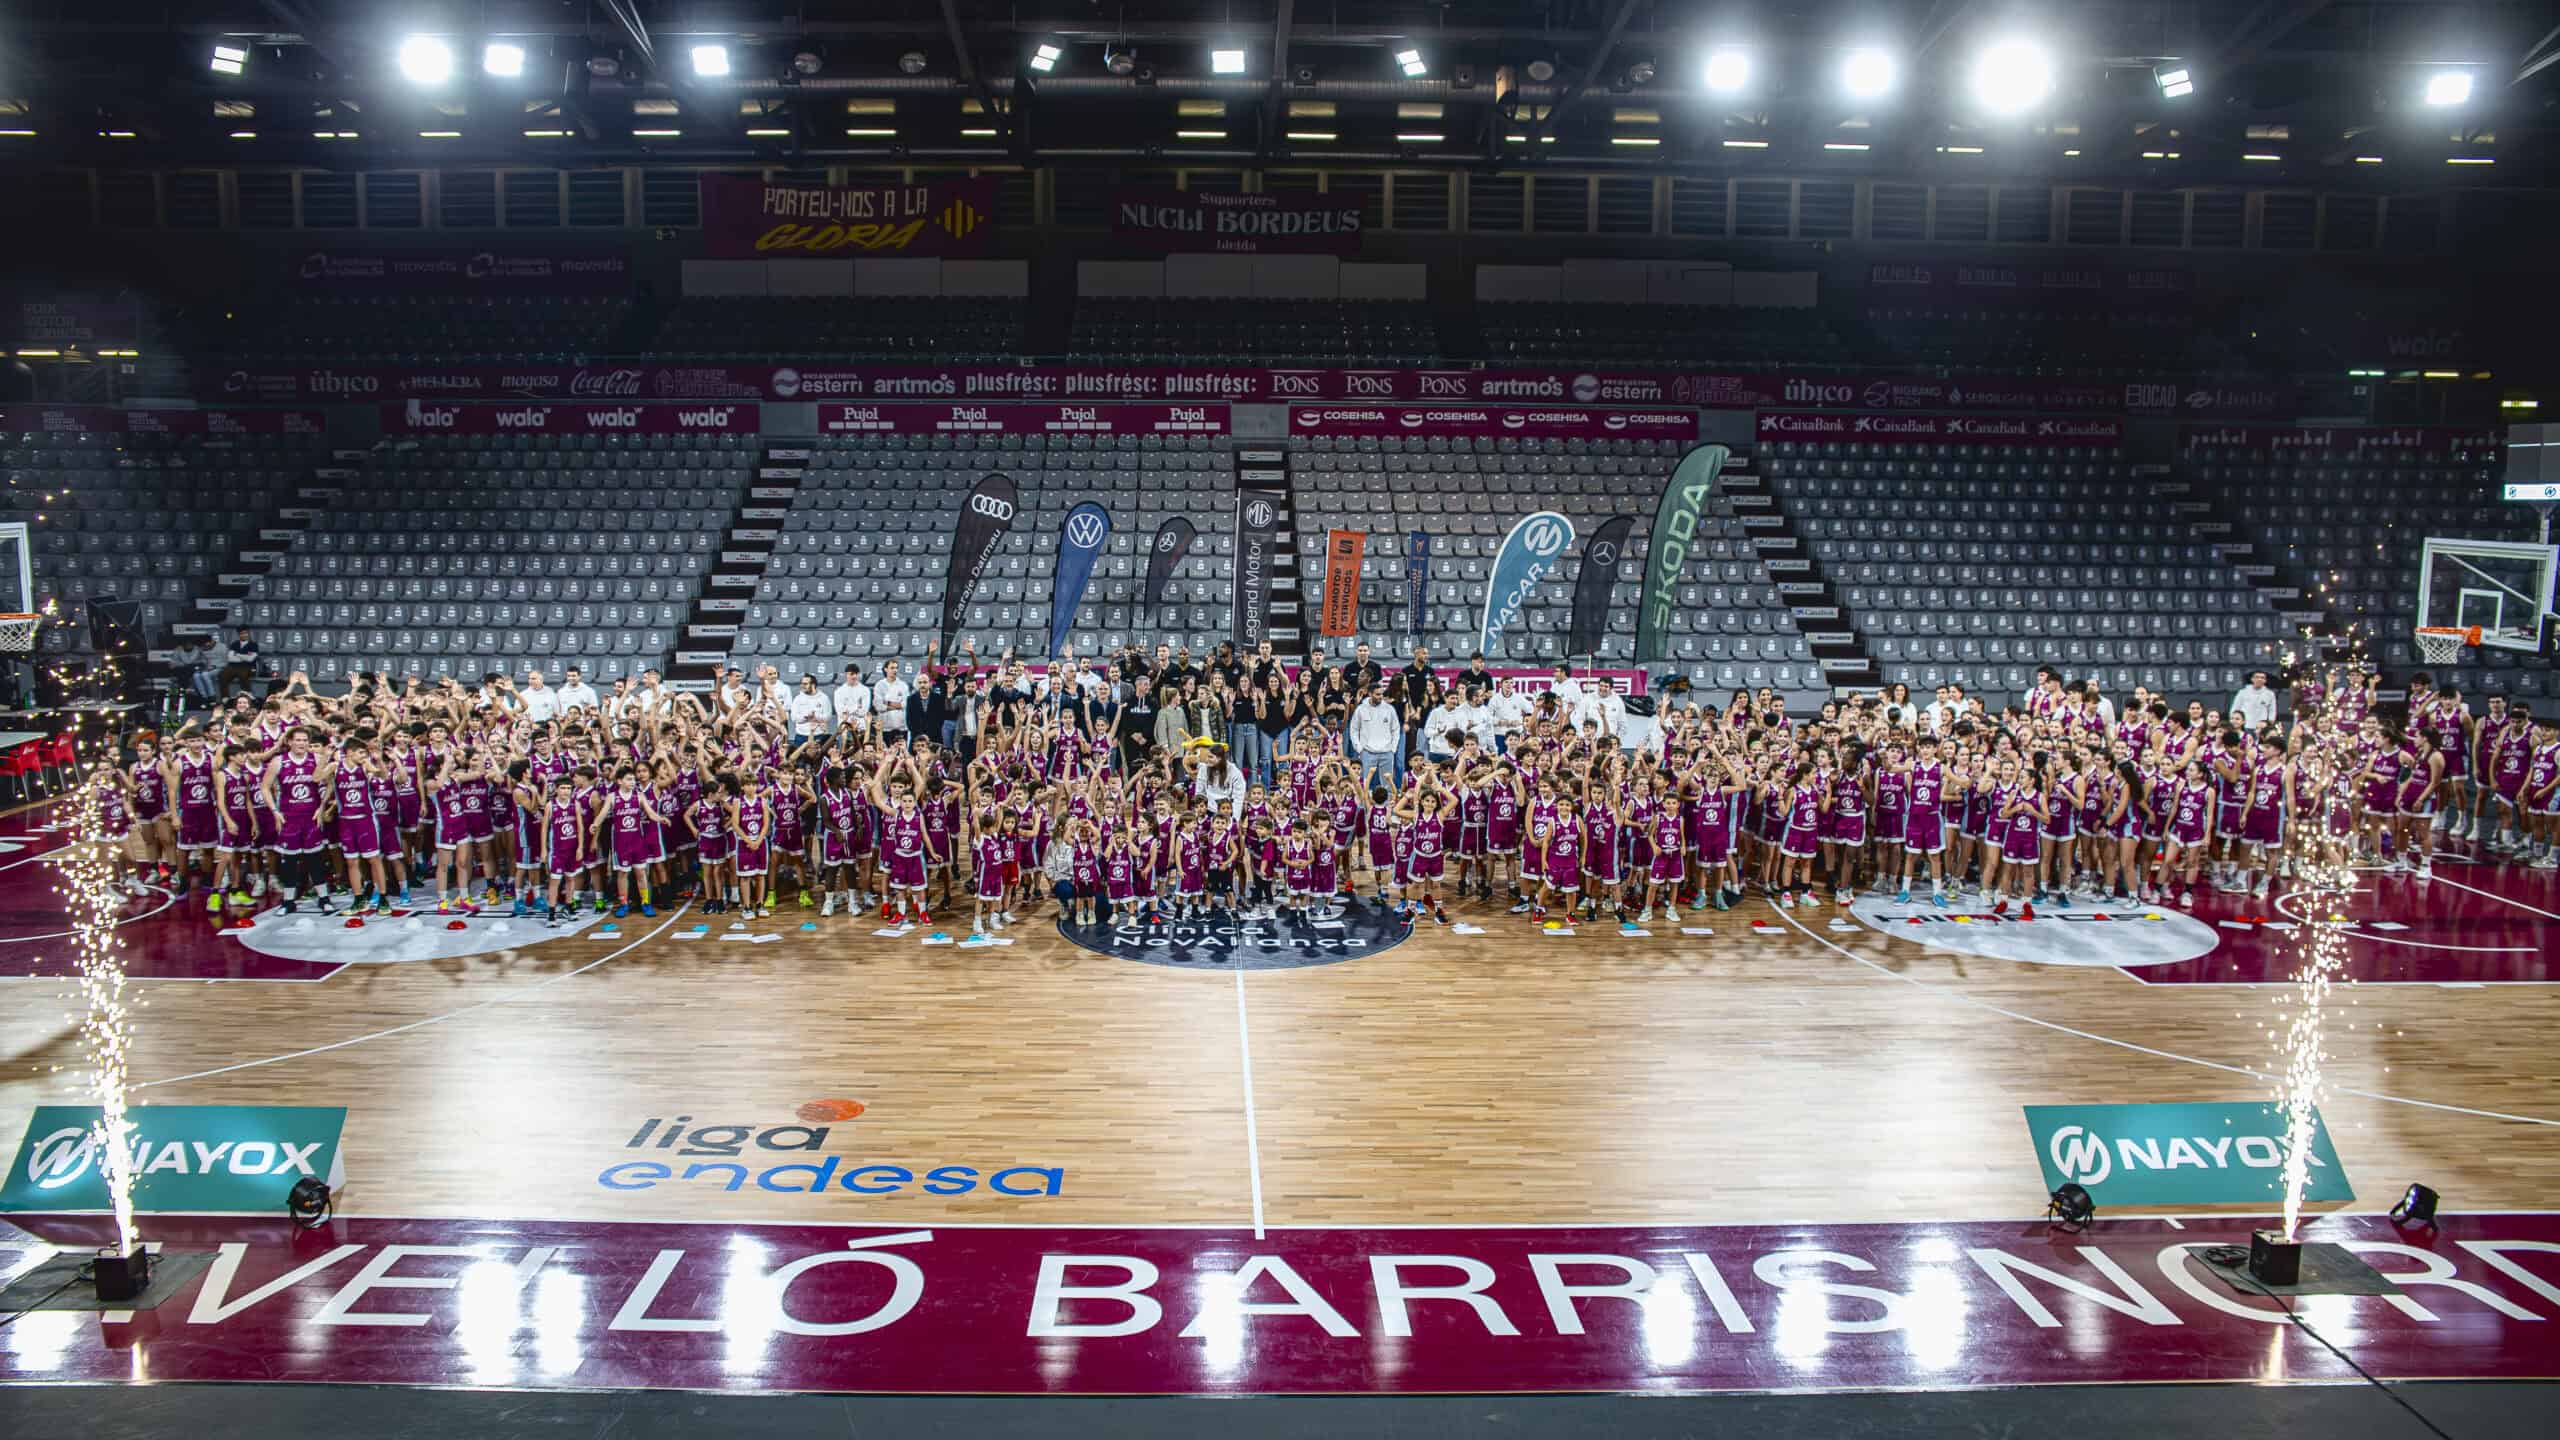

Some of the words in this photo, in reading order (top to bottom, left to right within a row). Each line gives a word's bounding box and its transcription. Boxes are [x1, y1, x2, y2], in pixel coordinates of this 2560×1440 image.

[763, 187, 875, 217] PORTEU-NOS
[884, 190, 896, 216] A
[904, 187, 928, 216] LA
[1200, 191, 1277, 206] Supporters
[1216, 209, 1361, 233] BORDEUS
[801, 377, 863, 394] esterri
[1273, 375, 1320, 394] PONS
[1346, 375, 1393, 394] PONS
[1420, 375, 1467, 395] PONS
[843, 407, 879, 421] Pujol
[952, 407, 987, 421] Pujol
[1061, 407, 1096, 422] Pujol
[1170, 407, 1206, 422] Pujol
[1323, 411, 1385, 421] COSEHISA
[1426, 411, 1488, 422] COSEHISA
[1528, 413, 1589, 423] COSEHISA
[1629, 414, 1690, 424] COSEHISA
[1245, 538, 1262, 587] Motor
[1654, 484, 1710, 629] SKODA
[953, 577, 977, 621] Garaje
[971, 528, 1001, 580] Dalmau
[1242, 589, 1261, 647] Legend
[1373, 815, 1386, 829] 88
[625, 1115, 830, 1157] liga
[597, 1156, 1065, 1197] endesa
[1025, 1250, 1912, 1338] BARRIS
